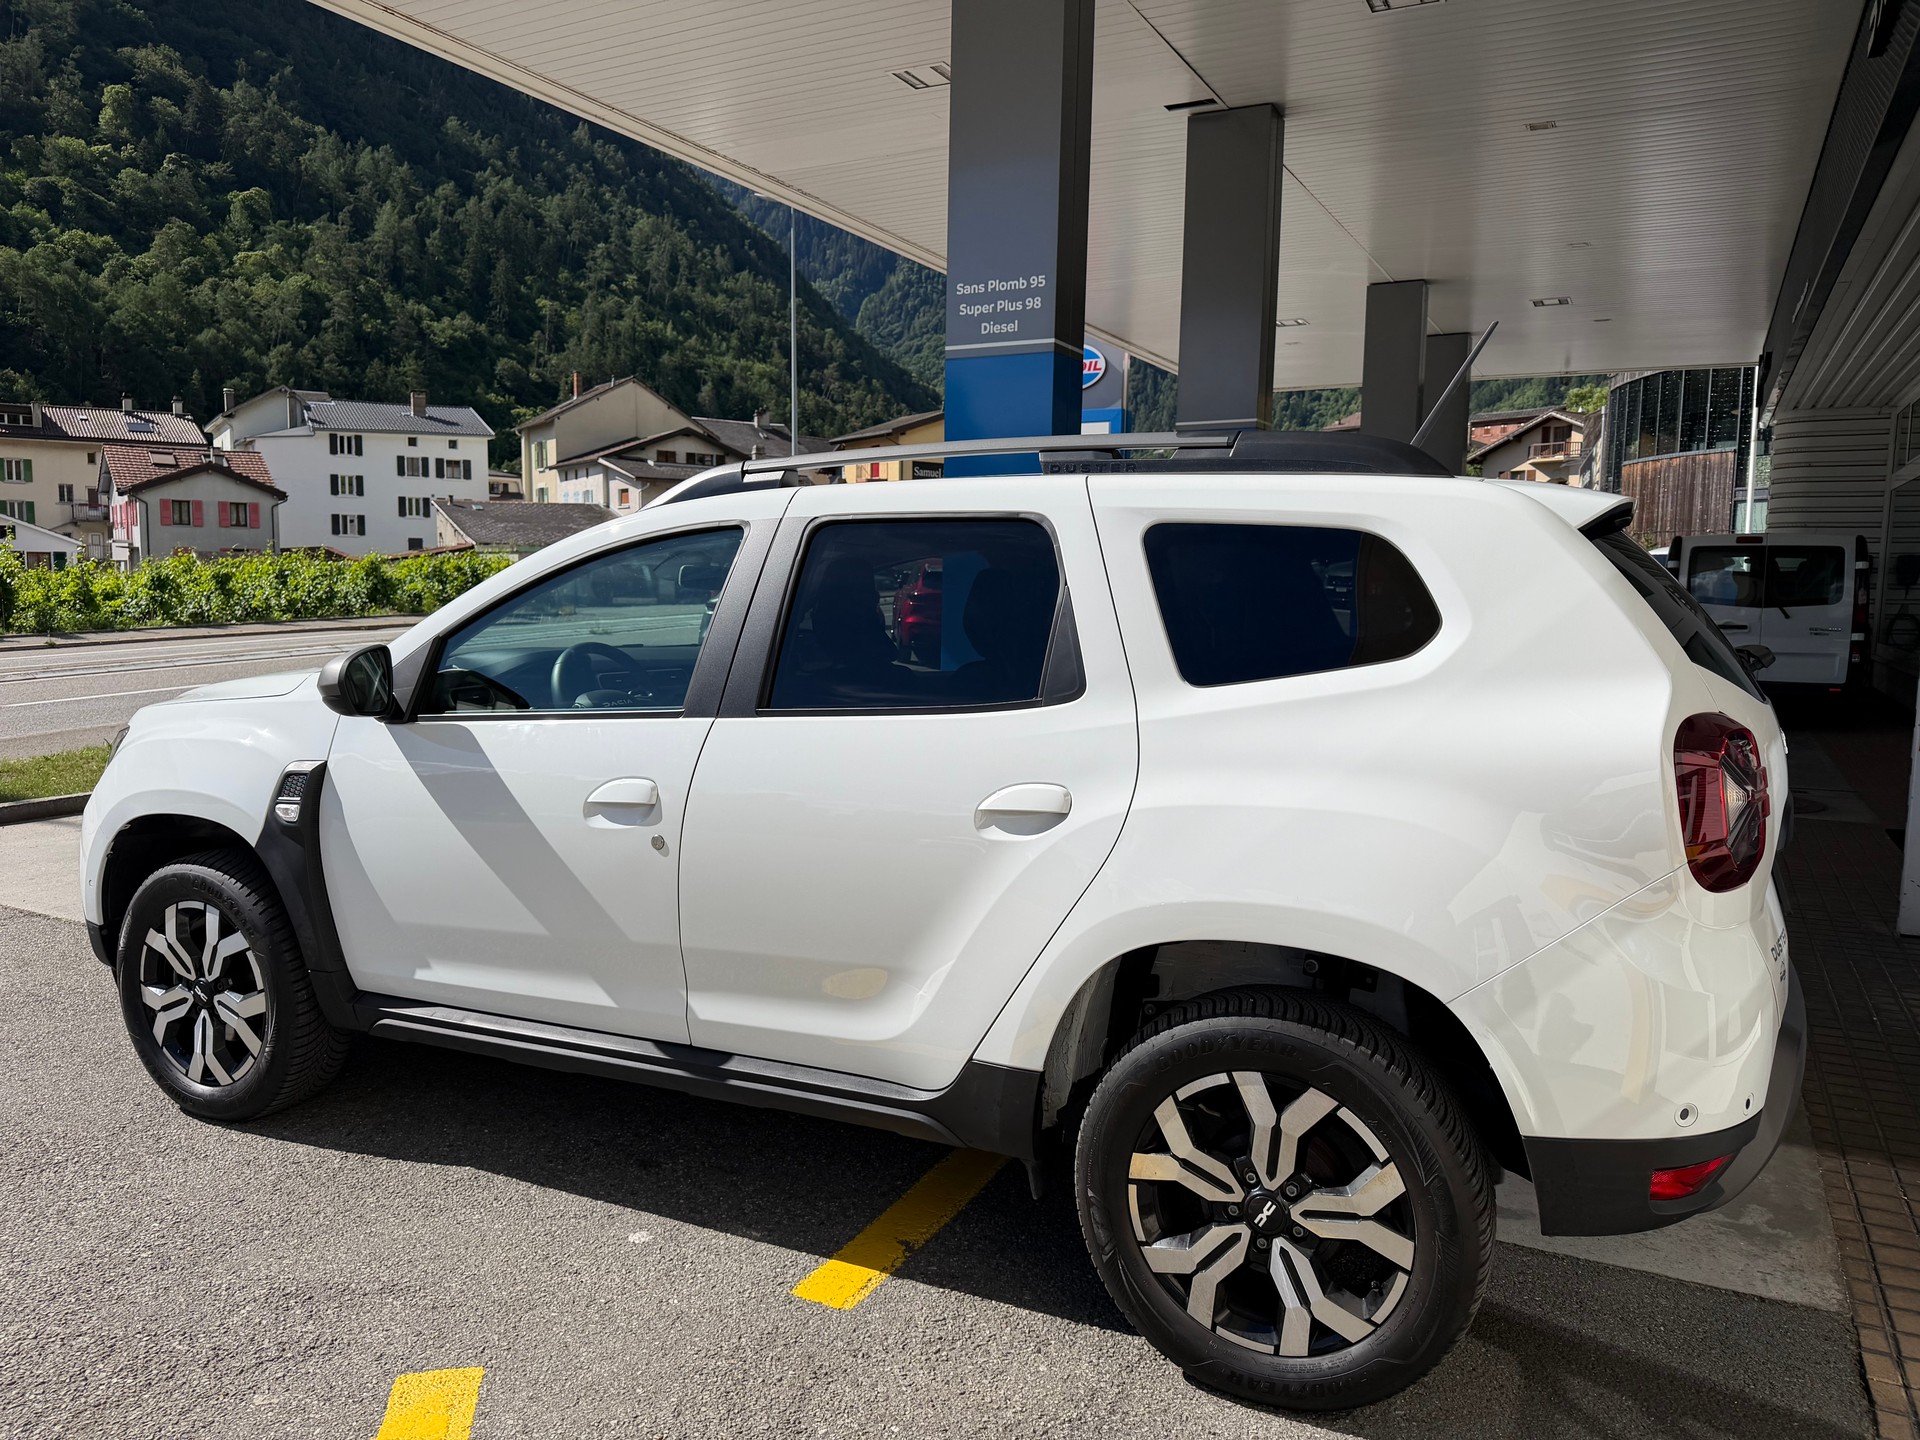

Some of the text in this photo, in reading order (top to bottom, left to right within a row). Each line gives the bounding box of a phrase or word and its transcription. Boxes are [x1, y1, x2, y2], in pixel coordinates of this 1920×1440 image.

[956, 275, 1046, 295] Sans Plomb 95
[959, 296, 1042, 317] Super Plus 98
[981, 319, 1018, 334] Diesel
[913, 466, 942, 479] Samuel
[1050, 463, 1136, 474] DUSTER
